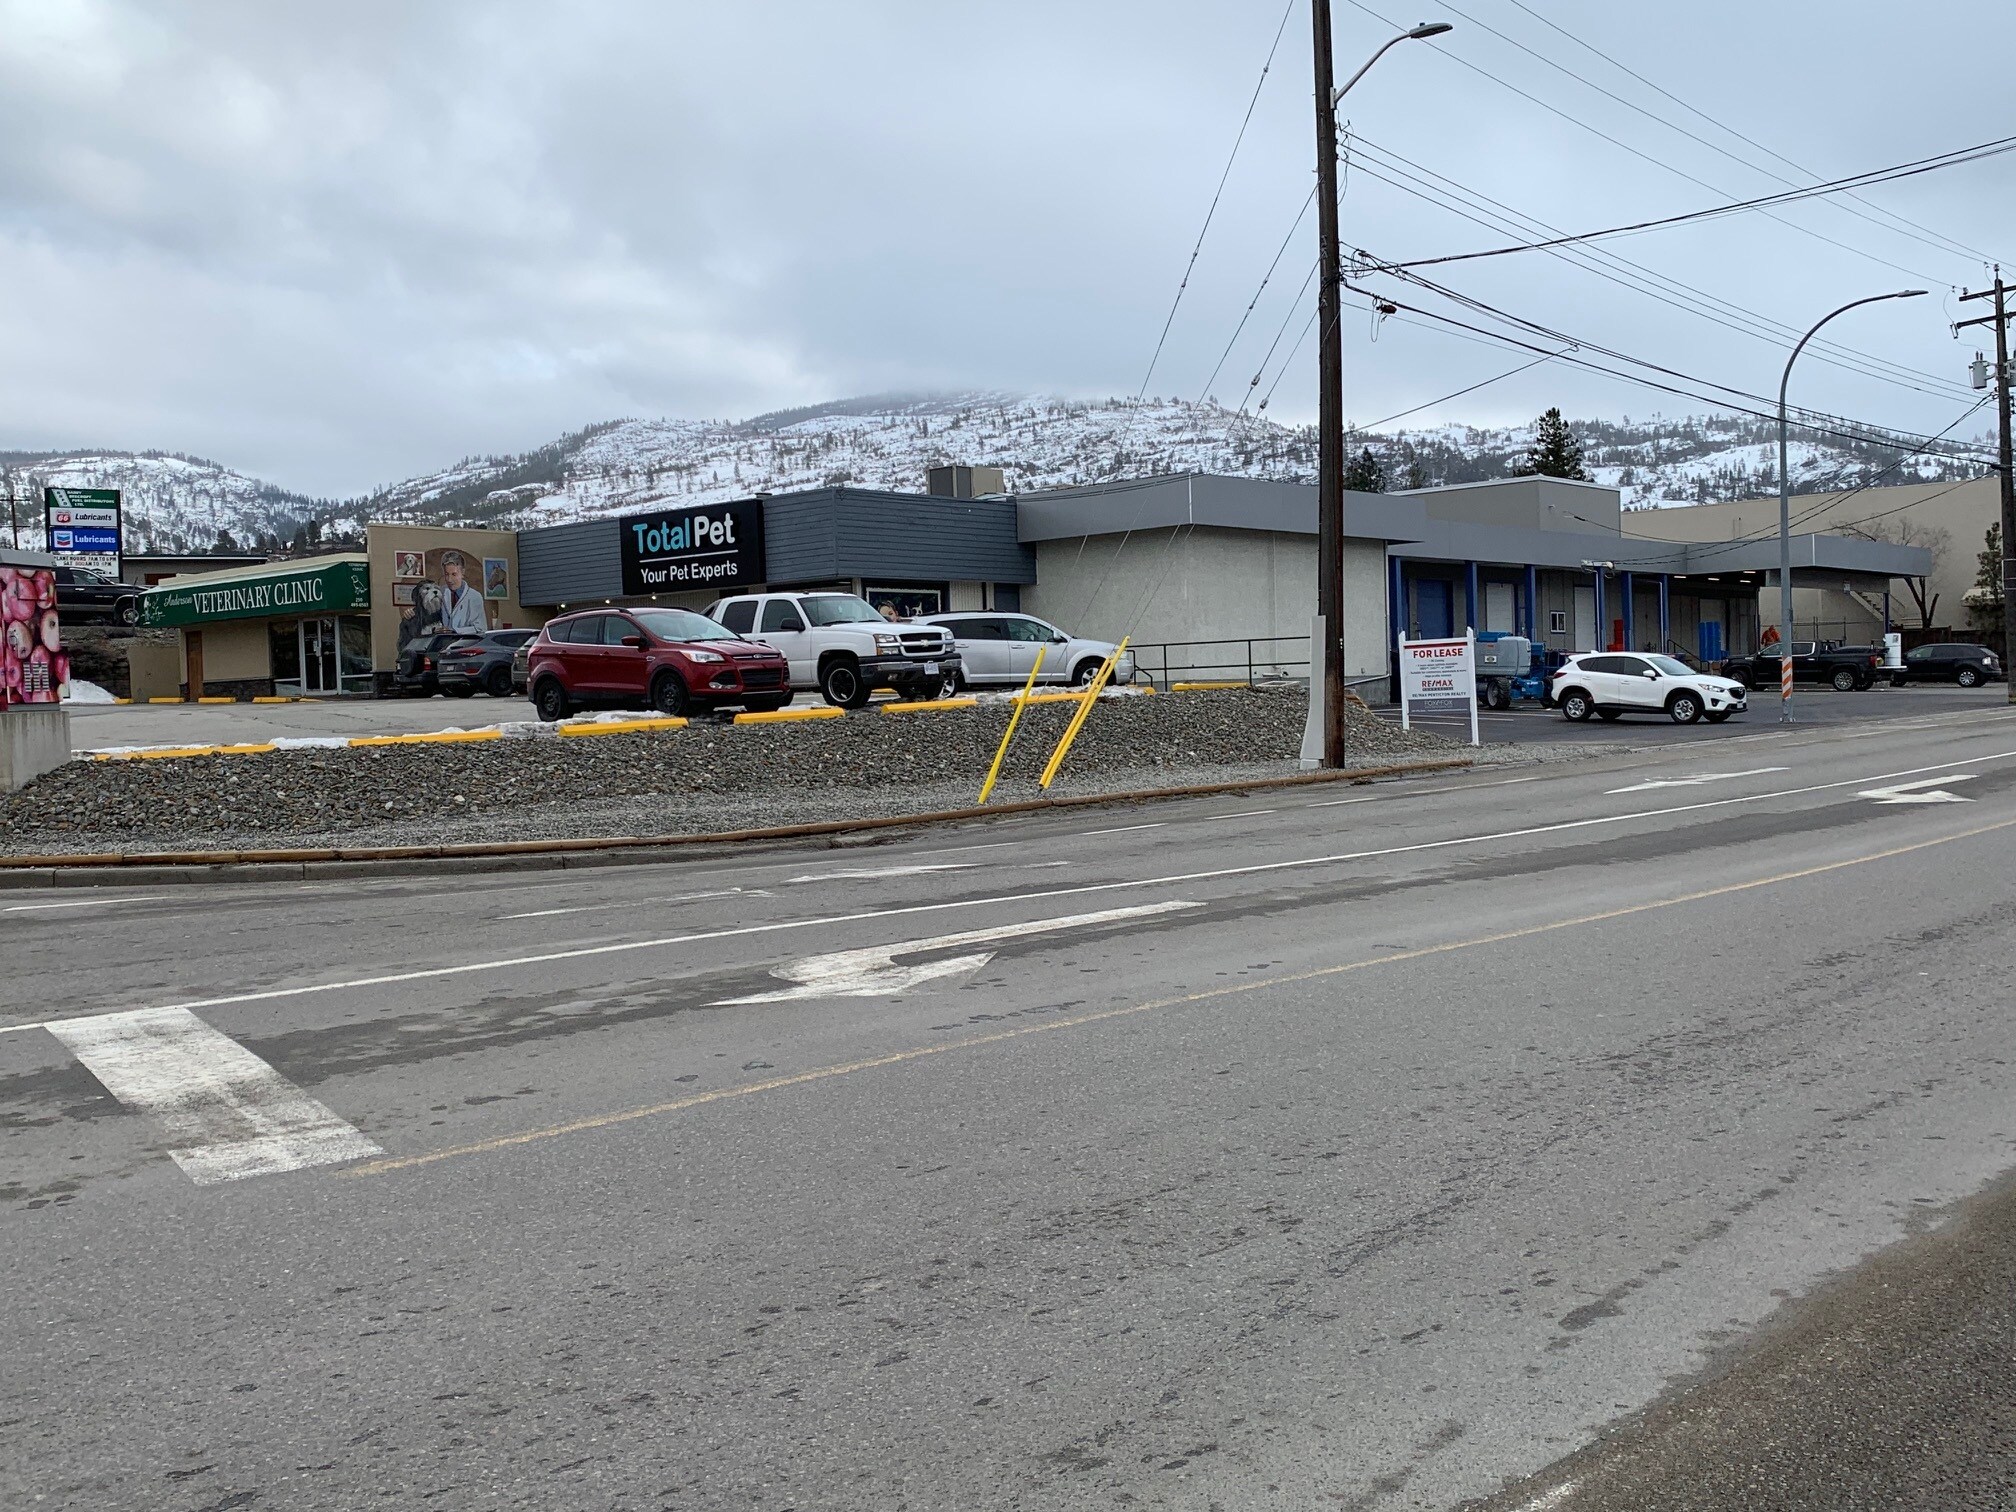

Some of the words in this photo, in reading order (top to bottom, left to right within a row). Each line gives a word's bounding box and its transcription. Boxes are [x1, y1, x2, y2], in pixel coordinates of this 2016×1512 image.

[75, 513, 112, 521] Lubricants
[74, 535, 116, 544] Lubricants
[641, 568, 667, 583] Your
[670, 565, 689, 581] Pet
[691, 560, 738, 581] Experts
[163, 593, 193, 607] Anderson
[193, 585, 271, 613] VETERINARY
[274, 578, 323, 606] CLINIC
[1413, 650, 1432, 658] FOR
[1434, 648, 1463, 657] LEASE
[1421, 679, 1454, 687] RE/MAX
